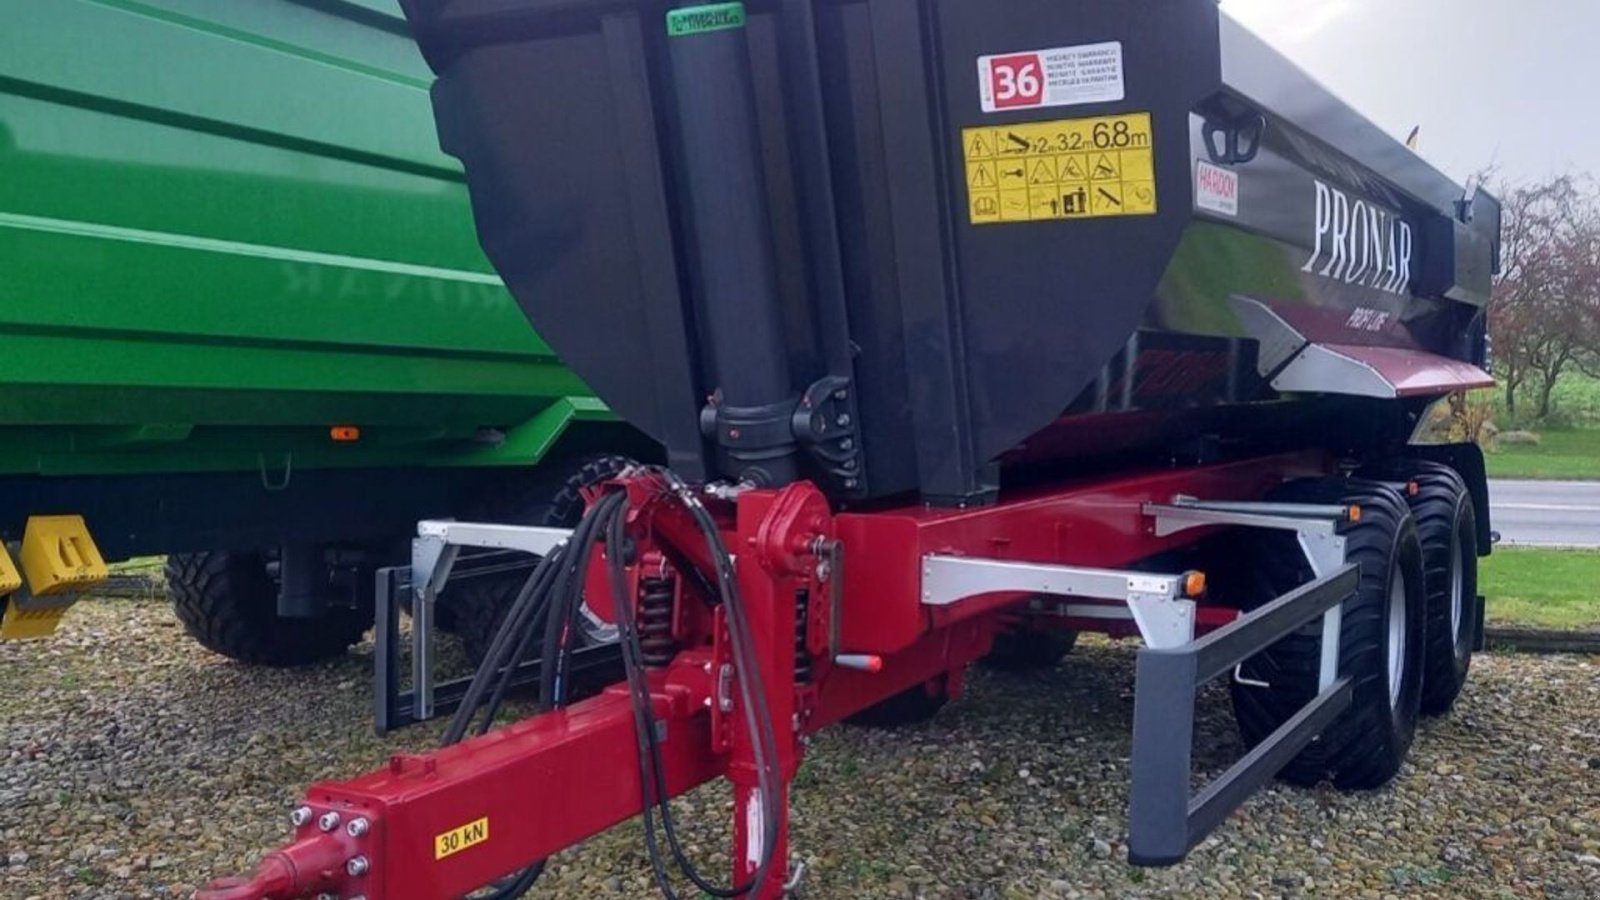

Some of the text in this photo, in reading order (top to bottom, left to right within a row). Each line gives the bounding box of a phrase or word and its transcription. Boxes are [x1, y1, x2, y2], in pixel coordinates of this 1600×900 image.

[994, 63, 1040, 100] 36
[1301, 179, 1412, 295] PRONAR
[440, 821, 484, 854] 30 kN
